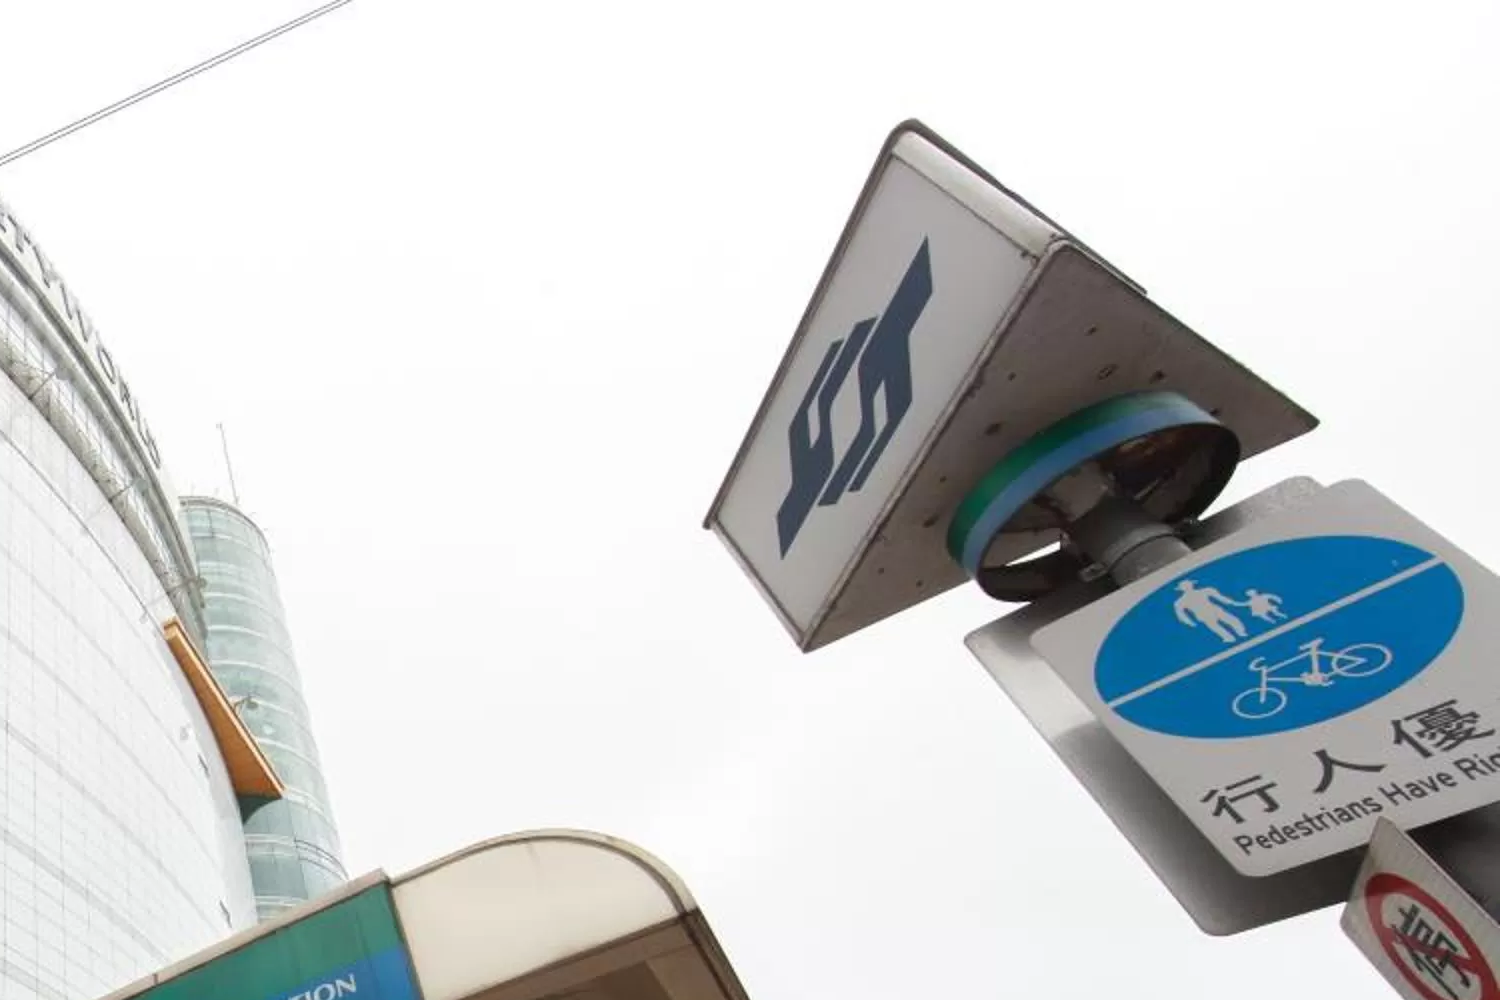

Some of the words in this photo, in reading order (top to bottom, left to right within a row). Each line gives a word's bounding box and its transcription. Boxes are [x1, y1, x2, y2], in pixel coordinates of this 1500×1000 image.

[1201, 699, 1496, 824] 行人優
[1232, 796, 1384, 856] Pedestrians
[1378, 771, 1458, 806] Have
